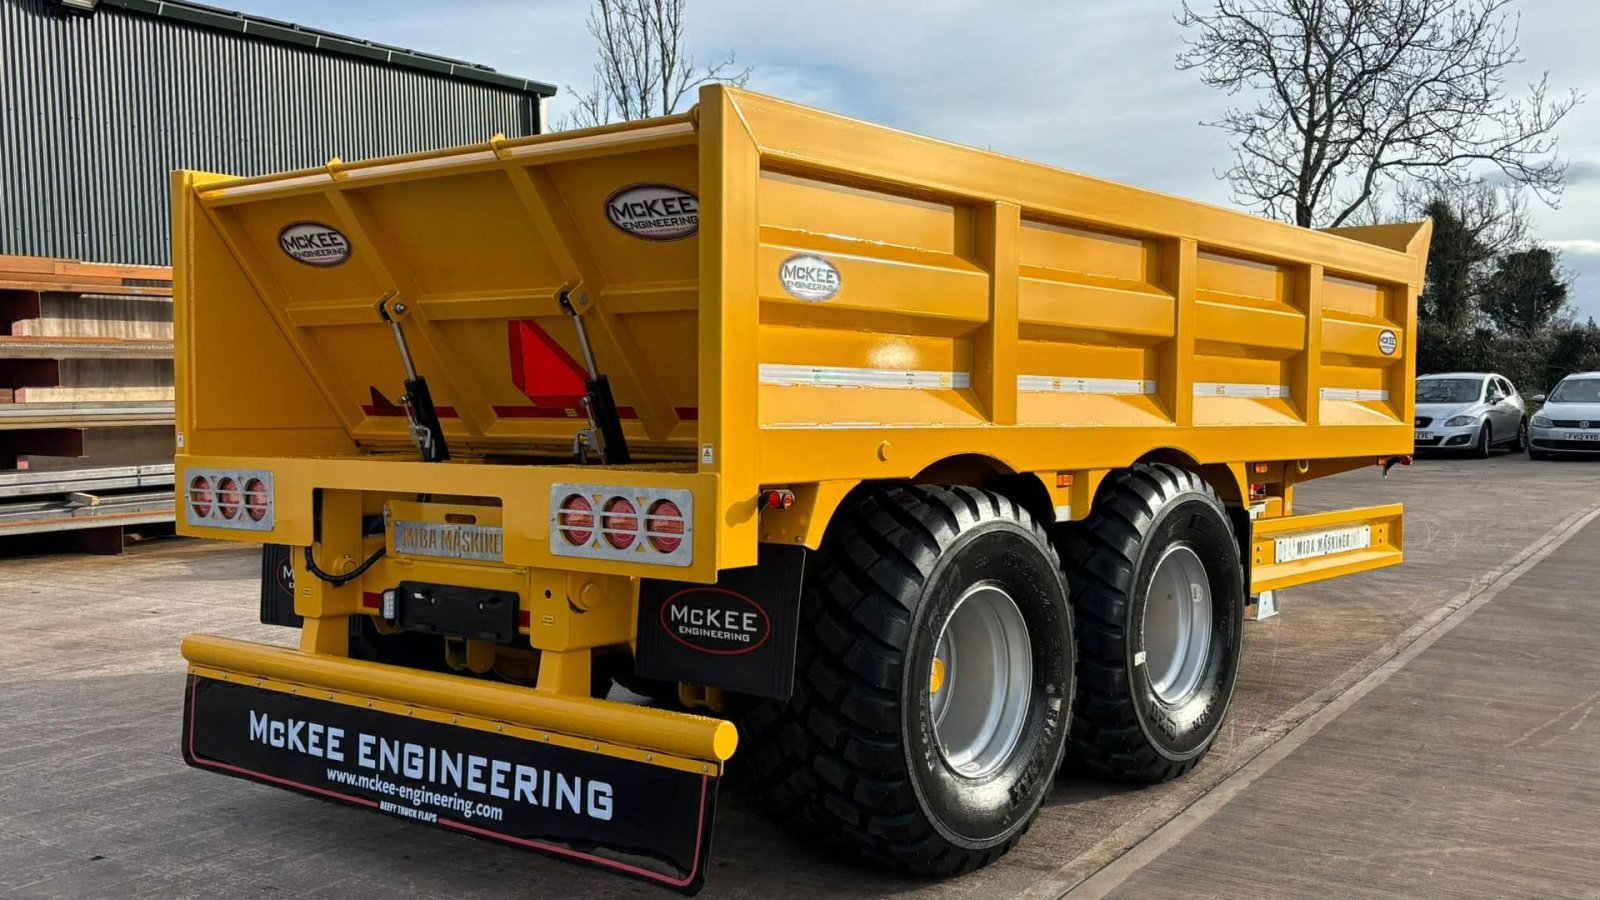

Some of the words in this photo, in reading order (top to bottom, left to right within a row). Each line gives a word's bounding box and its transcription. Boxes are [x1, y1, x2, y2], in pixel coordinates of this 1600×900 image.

[610, 196, 697, 220] McKEE
[622, 215, 699, 230] ENGINEERING
[671, 604, 757, 632] McKEE
[678, 625, 750, 642] ENGINEERING
[249, 709, 345, 762] McKEE
[358, 732, 614, 821] ENGINEERING
[326, 768, 503, 821] www.mckee-engineering.com
[398, 805, 417, 818] TRUCK
[418, 810, 437, 823] FLAPS
